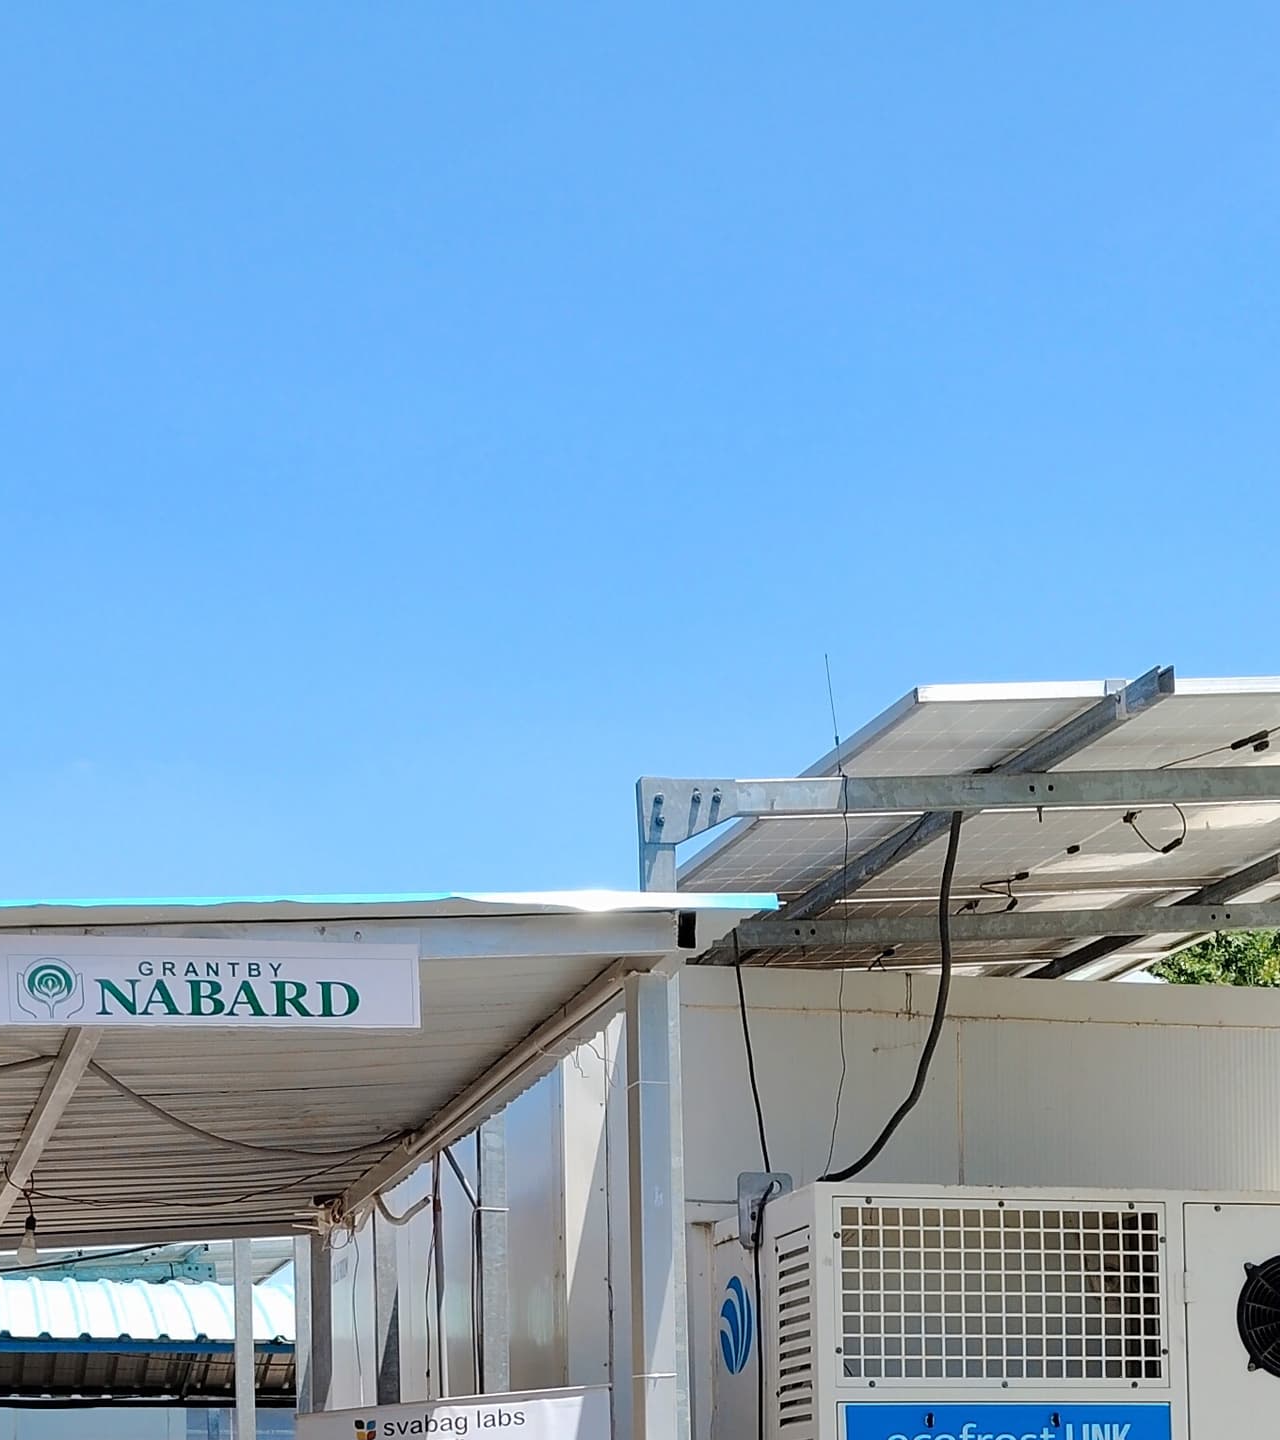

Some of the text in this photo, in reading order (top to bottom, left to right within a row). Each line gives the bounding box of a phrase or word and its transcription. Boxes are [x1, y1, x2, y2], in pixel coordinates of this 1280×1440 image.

[95, 978, 360, 1018] NABARD
[383, 1409, 526, 1437] svabag labs
